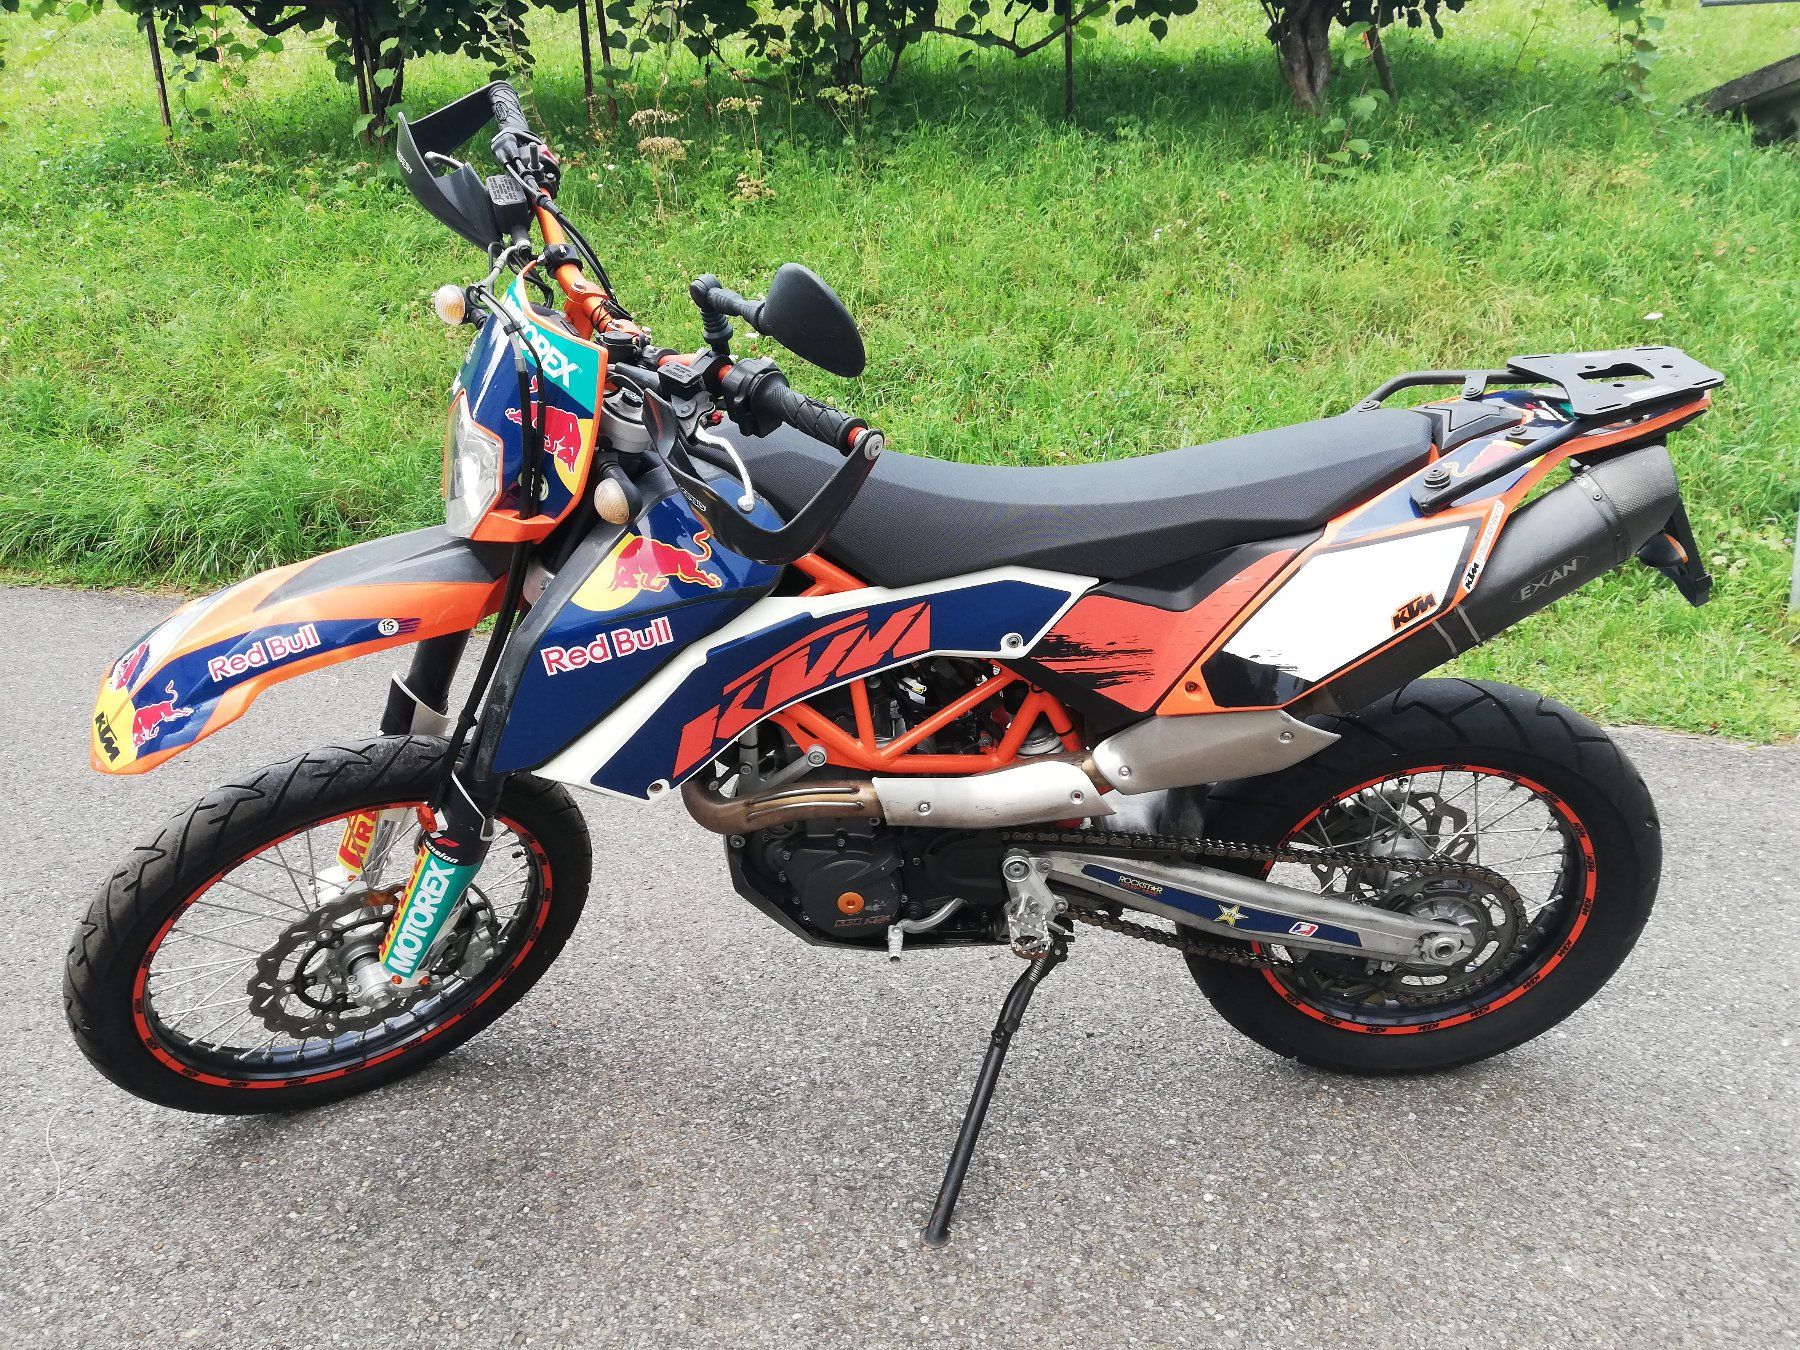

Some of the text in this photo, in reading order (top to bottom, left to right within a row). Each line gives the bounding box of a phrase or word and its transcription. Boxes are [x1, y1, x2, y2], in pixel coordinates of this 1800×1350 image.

[1465, 501, 1503, 590] KTM POWERPARTS
[1520, 557, 1578, 601] EXAN
[1392, 593, 1437, 631] KTM
[208, 624, 321, 682] Red Bull
[542, 616, 674, 676] Red Bull
[672, 602, 932, 779] KTM
[95, 711, 120, 763] KTM
[388, 859, 456, 974] MOTOREX
